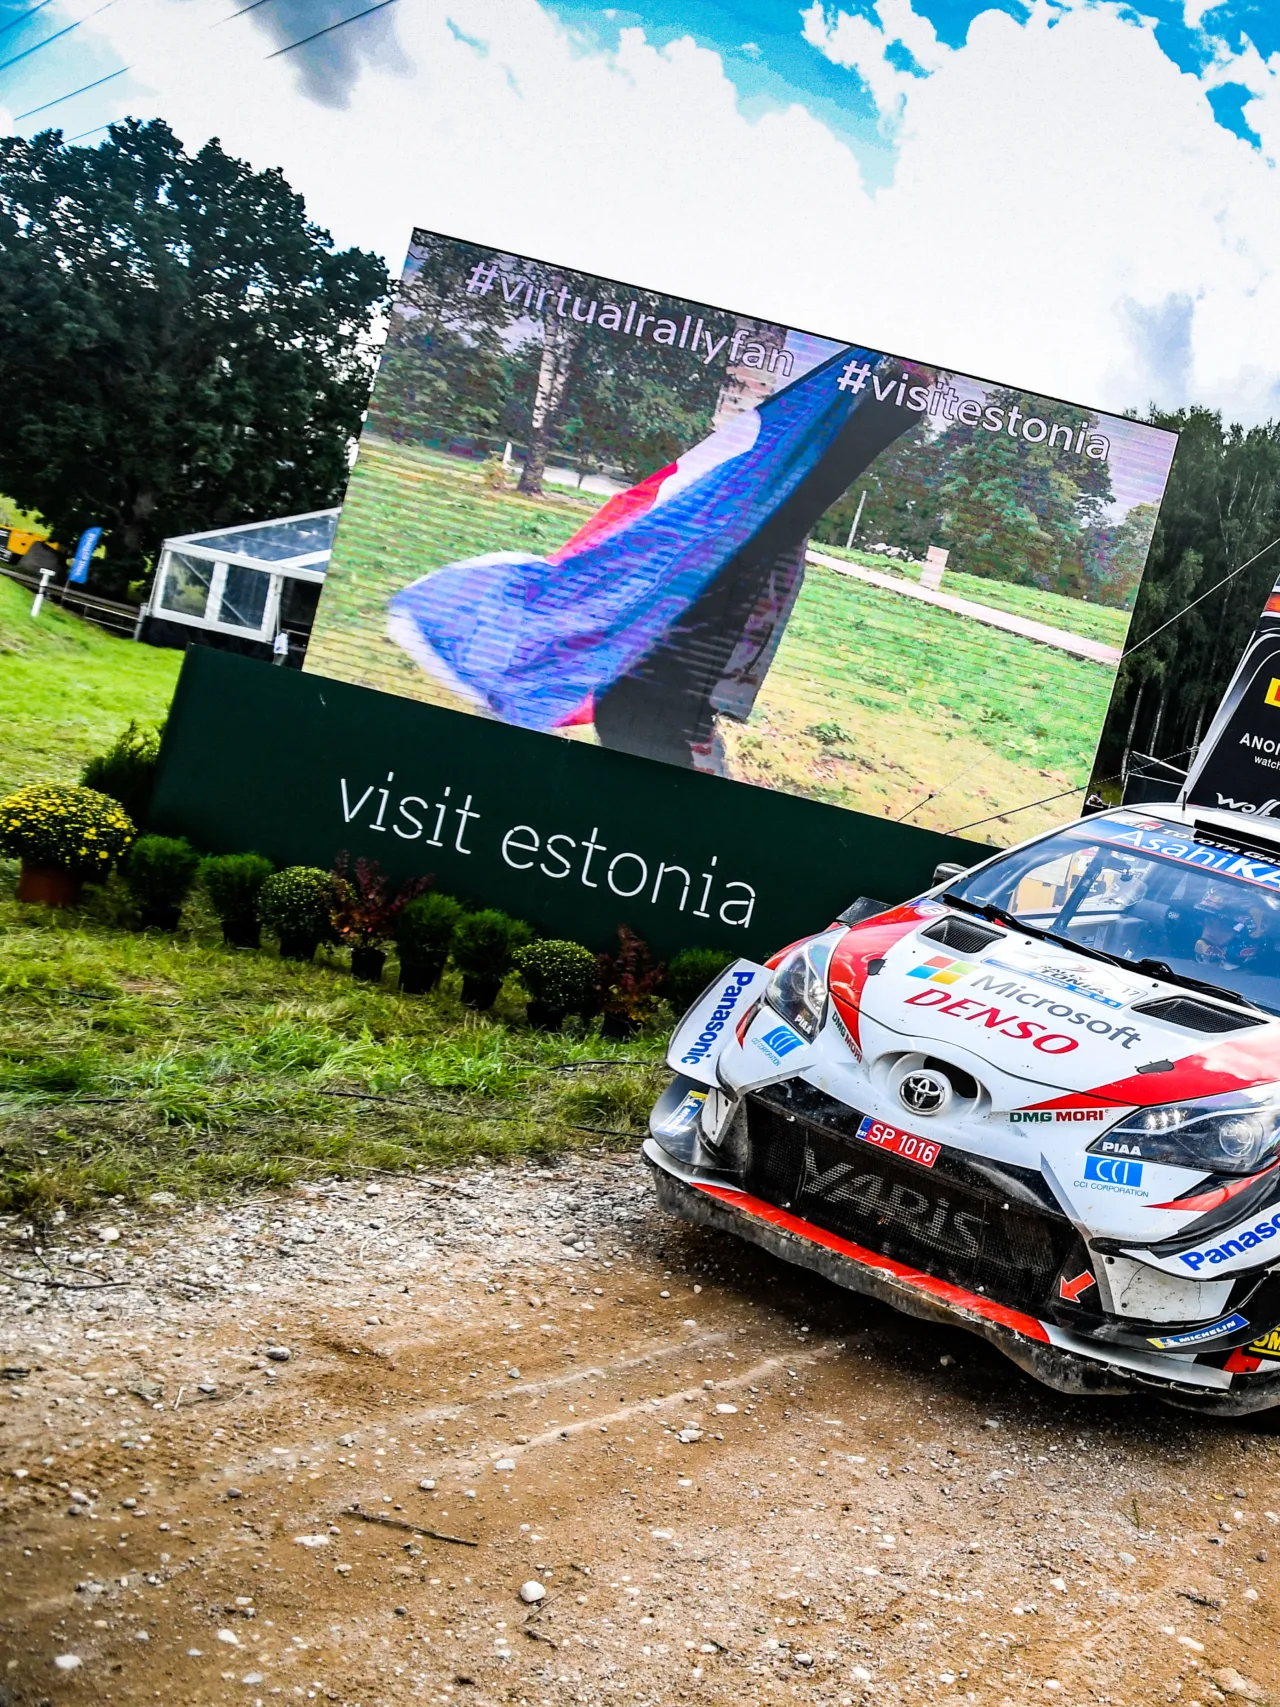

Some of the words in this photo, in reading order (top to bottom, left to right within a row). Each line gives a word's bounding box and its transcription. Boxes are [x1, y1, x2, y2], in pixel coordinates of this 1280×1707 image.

[465, 261, 795, 379] #virtualrallyfan
[836, 359, 1112, 463] #visitestonia
[340, 771, 481, 855] visit
[501, 827, 757, 929] estonia
[1162, 828, 1241, 853] TOYOTA
[1121, 988, 1141, 997] 17
[680, 971, 756, 1065] Panasonic
[794, 1014, 813, 1035] PIAA
[903, 988, 1080, 1055] DENSO
[970, 974, 1142, 1050] Microsoft
[1009, 1111, 1053, 1123] DMG
[1055, 1109, 1104, 1122] MORI
[869, 1124, 896, 1144] SP
[897, 1135, 936, 1163] 1016
[1102, 1141, 1142, 1157] PIAA
[1096, 1159, 1130, 1185] CCI
[1073, 1180, 1089, 1189] CCI
[1090, 1183, 1150, 1198] CORPORATION
[1178, 1320, 1237, 1344] MICHELIN
